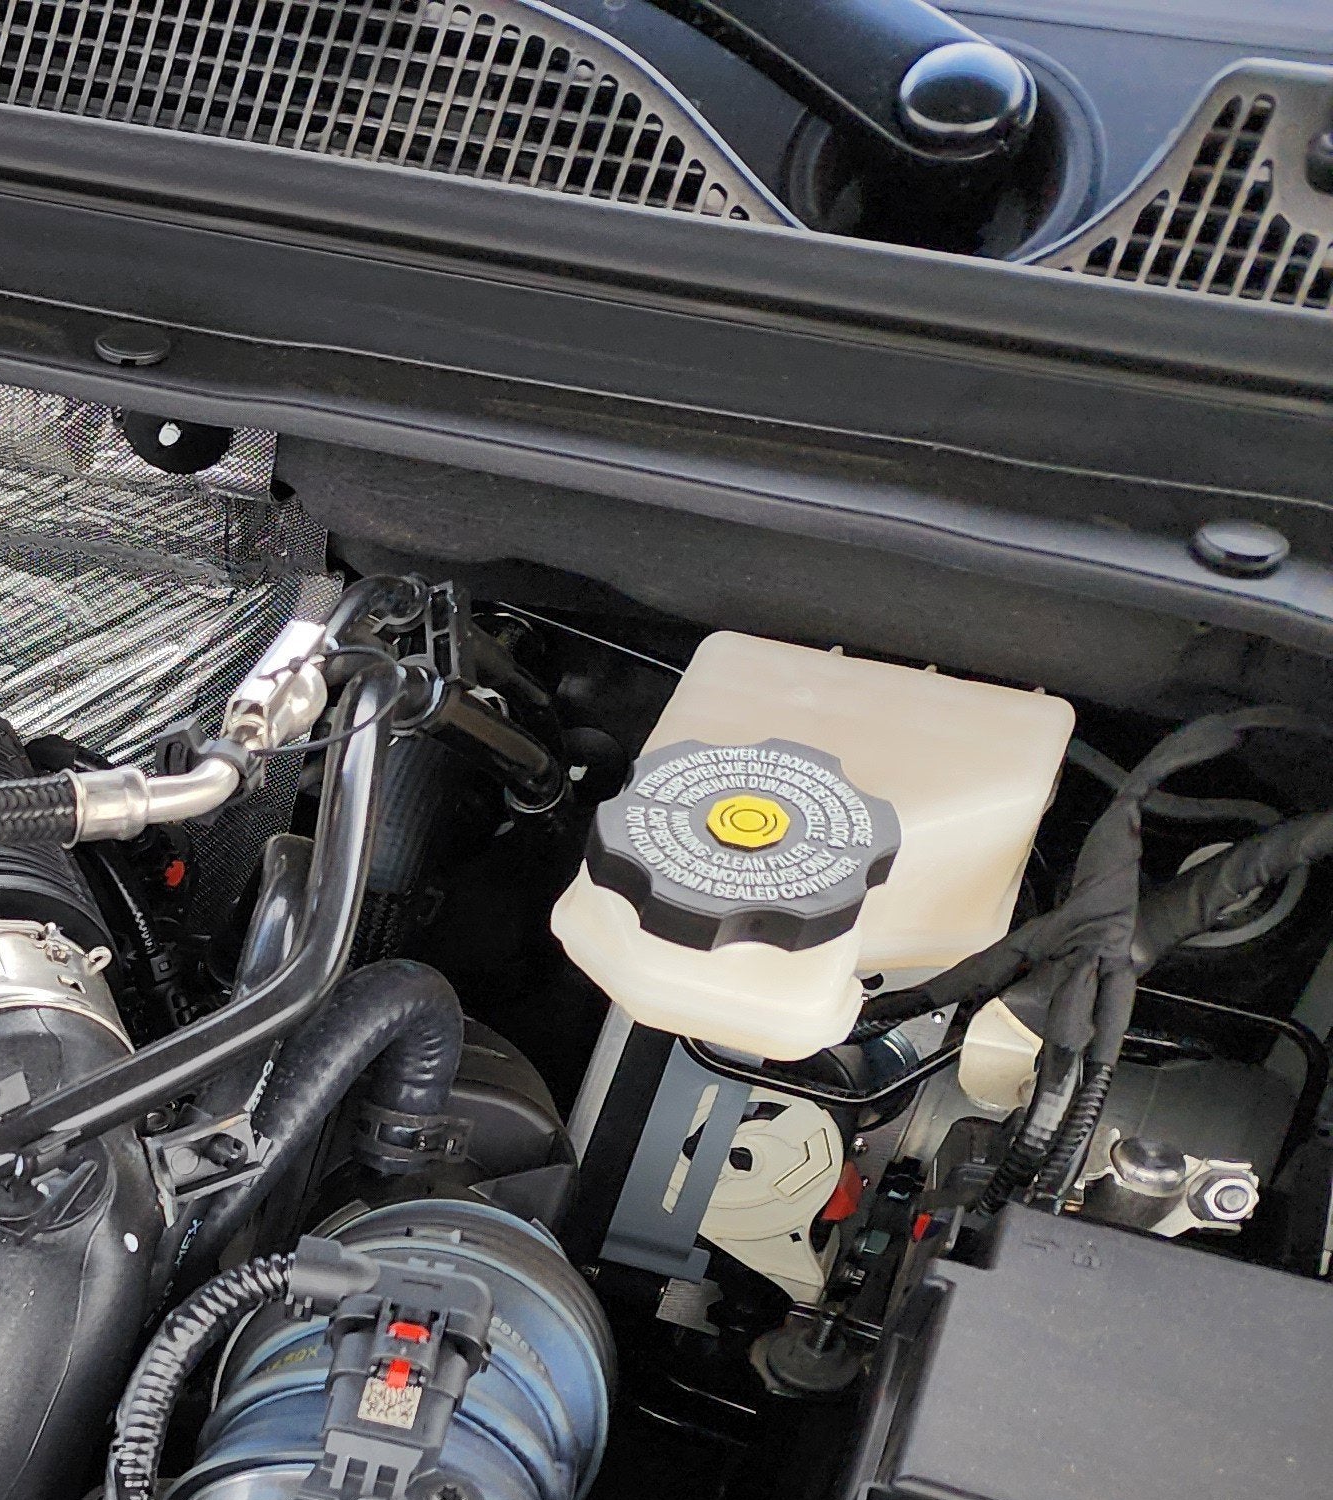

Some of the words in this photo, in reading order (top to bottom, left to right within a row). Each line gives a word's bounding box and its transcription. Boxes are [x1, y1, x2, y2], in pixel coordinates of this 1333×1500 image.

[687, 748, 759, 765] NETTOYER
[760, 750, 781, 764] LE
[715, 761, 747, 774] QUE
[647, 806, 669, 830] CAP
[649, 829, 699, 867] BEFORE
[711, 851, 767, 872] CLEAN
[767, 843, 817, 869] FILLER
[798, 848, 836, 876] ONLY
[627, 833, 668, 865] FLUID
[652, 859, 703, 890] FROM
[711, 878, 782, 901] SEALED
